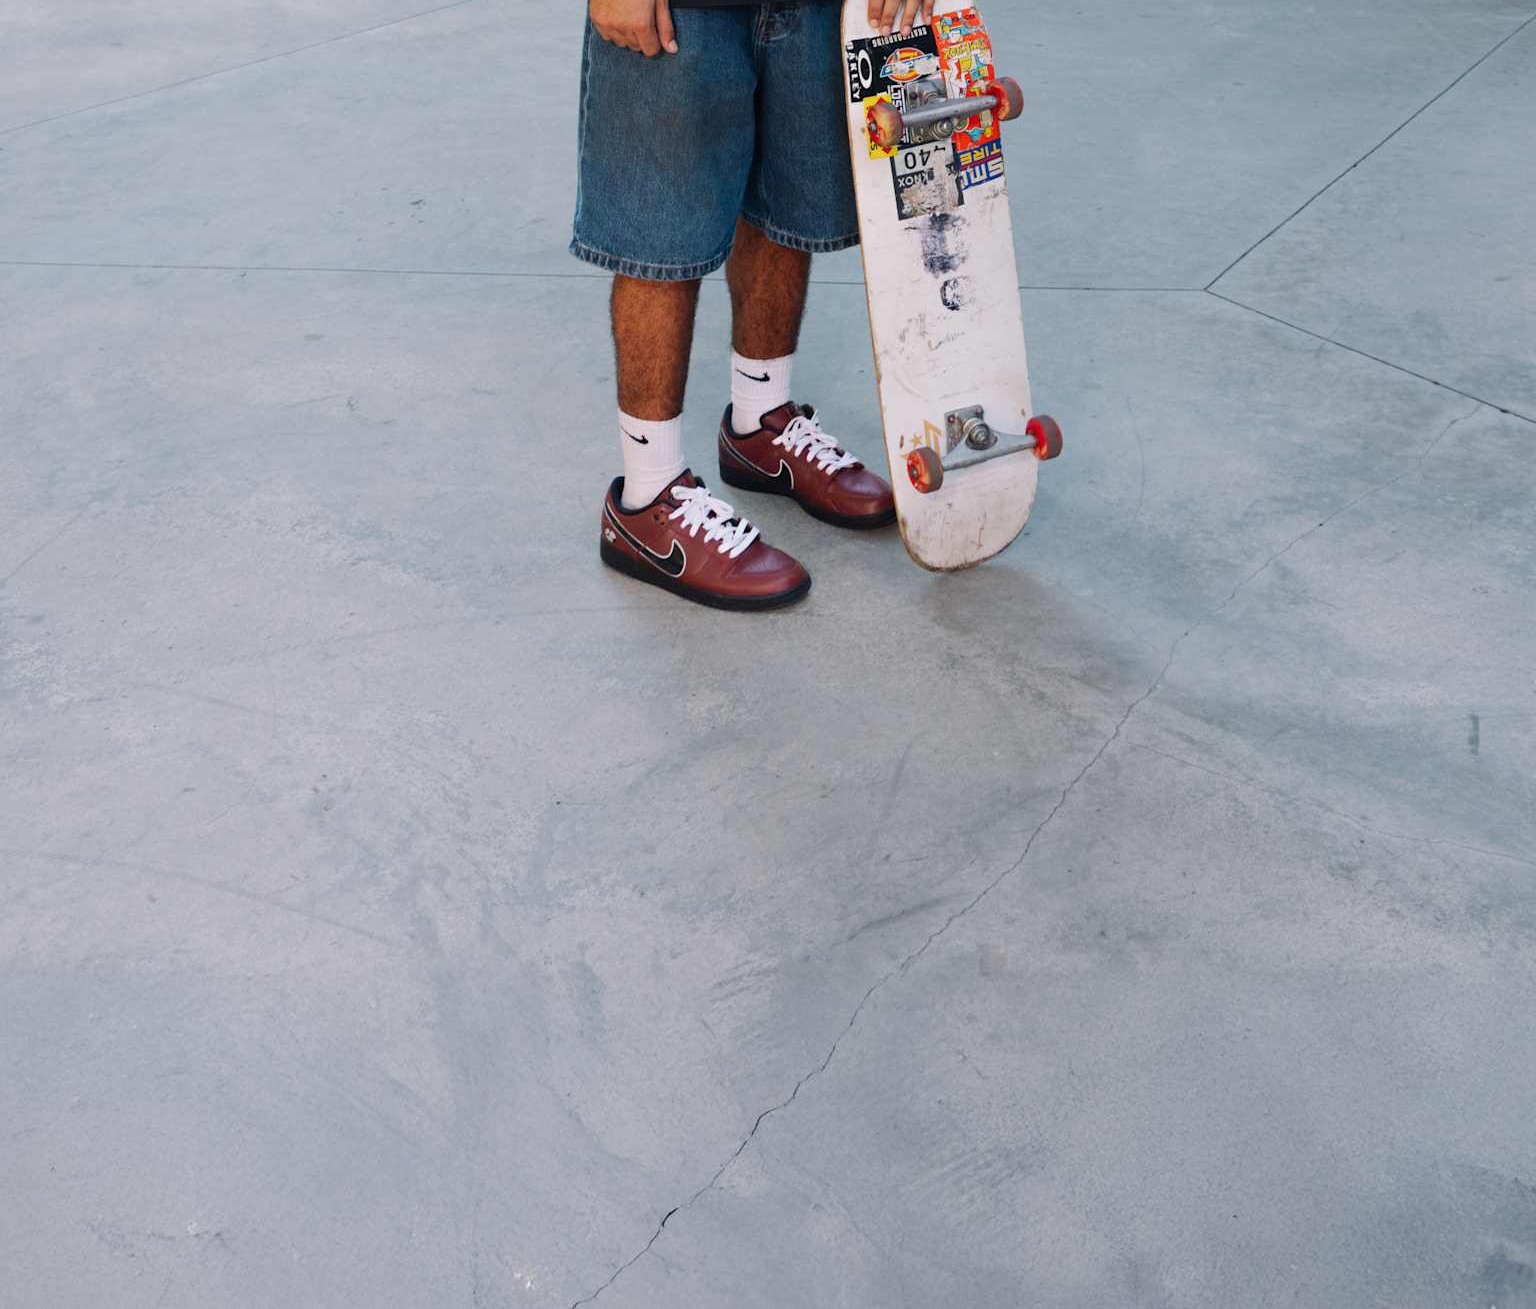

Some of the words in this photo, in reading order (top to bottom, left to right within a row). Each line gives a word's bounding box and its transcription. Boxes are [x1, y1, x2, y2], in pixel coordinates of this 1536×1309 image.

[846, 41, 861, 100] OAKLEY
[959, 143, 1001, 166] TIRE
[898, 171, 930, 187] KNOX
